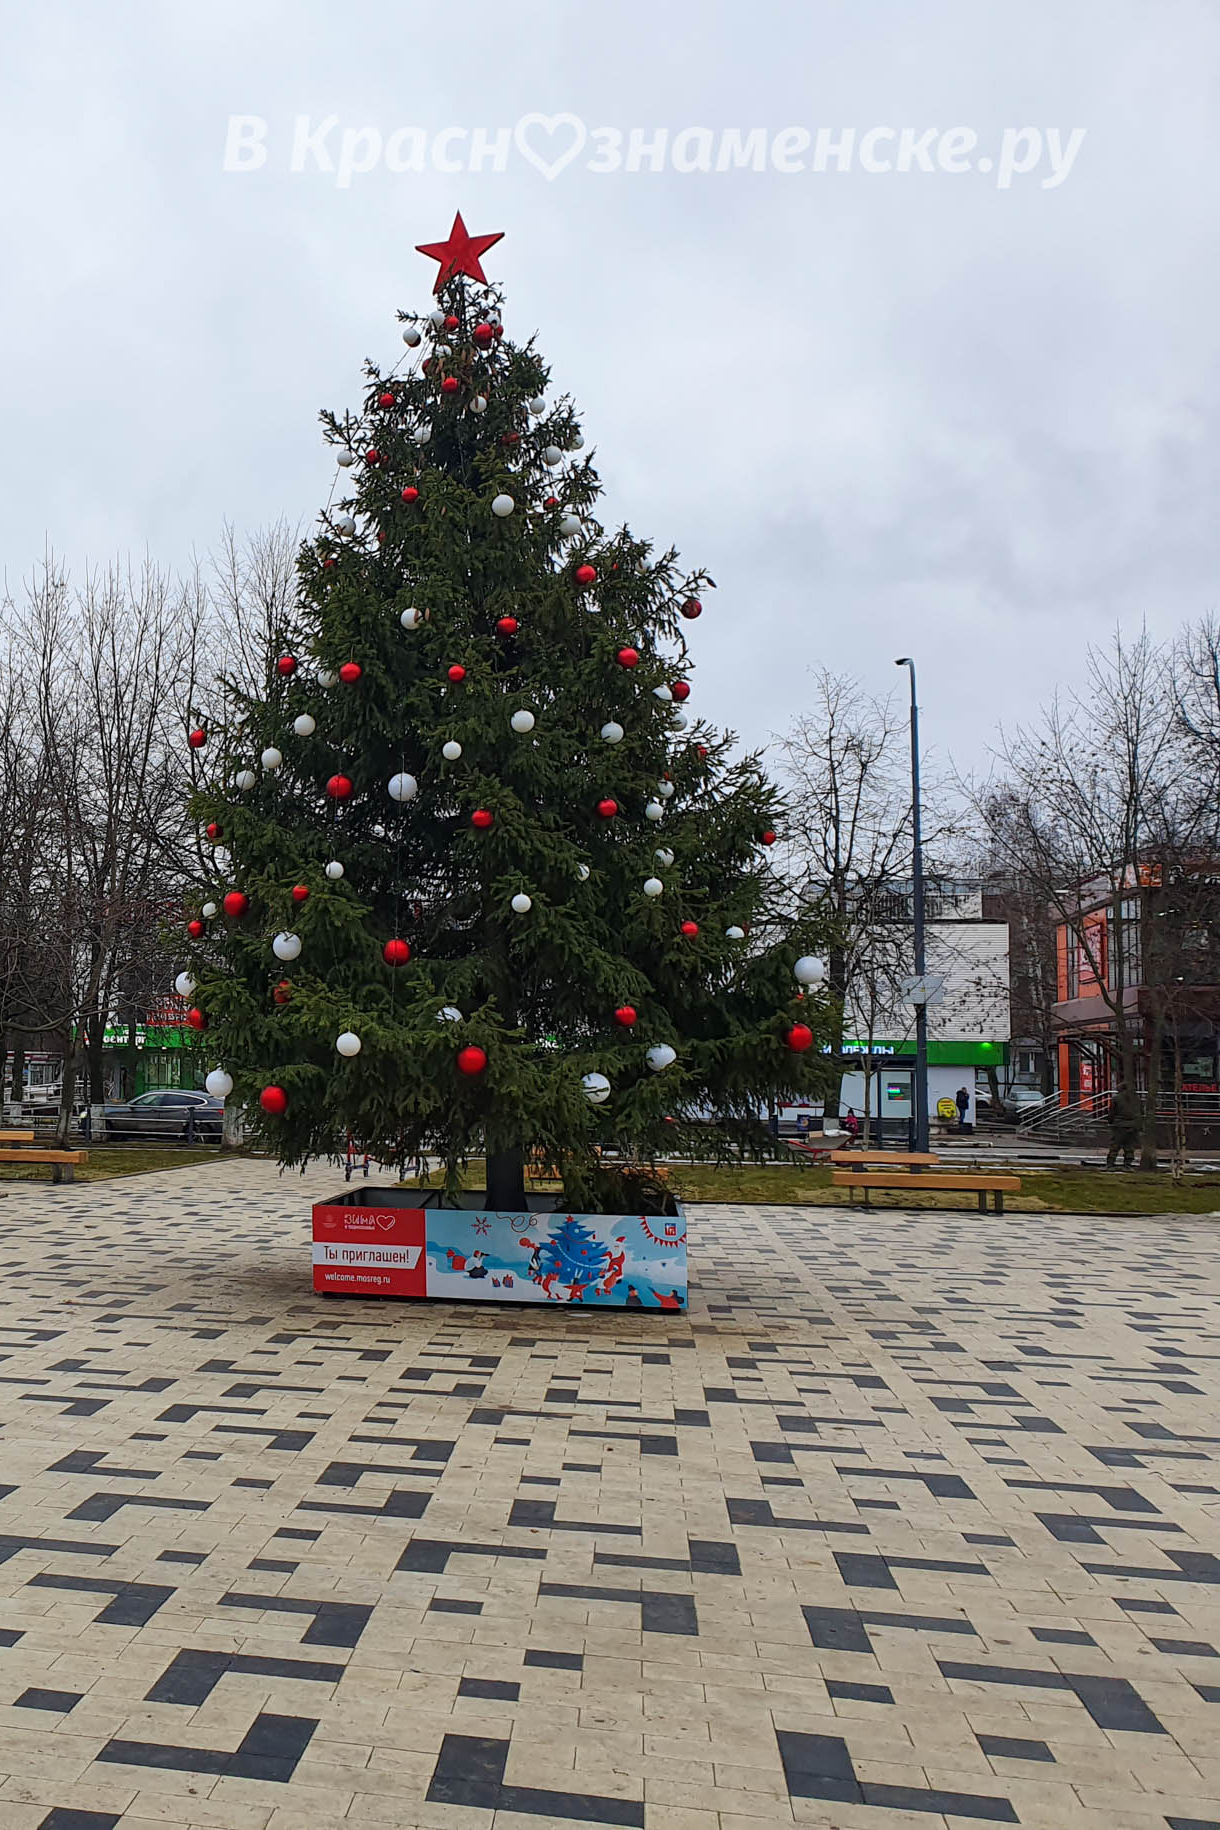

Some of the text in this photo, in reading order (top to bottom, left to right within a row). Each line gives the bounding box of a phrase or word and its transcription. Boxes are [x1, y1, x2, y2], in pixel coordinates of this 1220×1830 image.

[323, 1245, 409, 1264] Ты приглашен!
[325, 1272, 391, 1285] welcome.mosreg.ru
